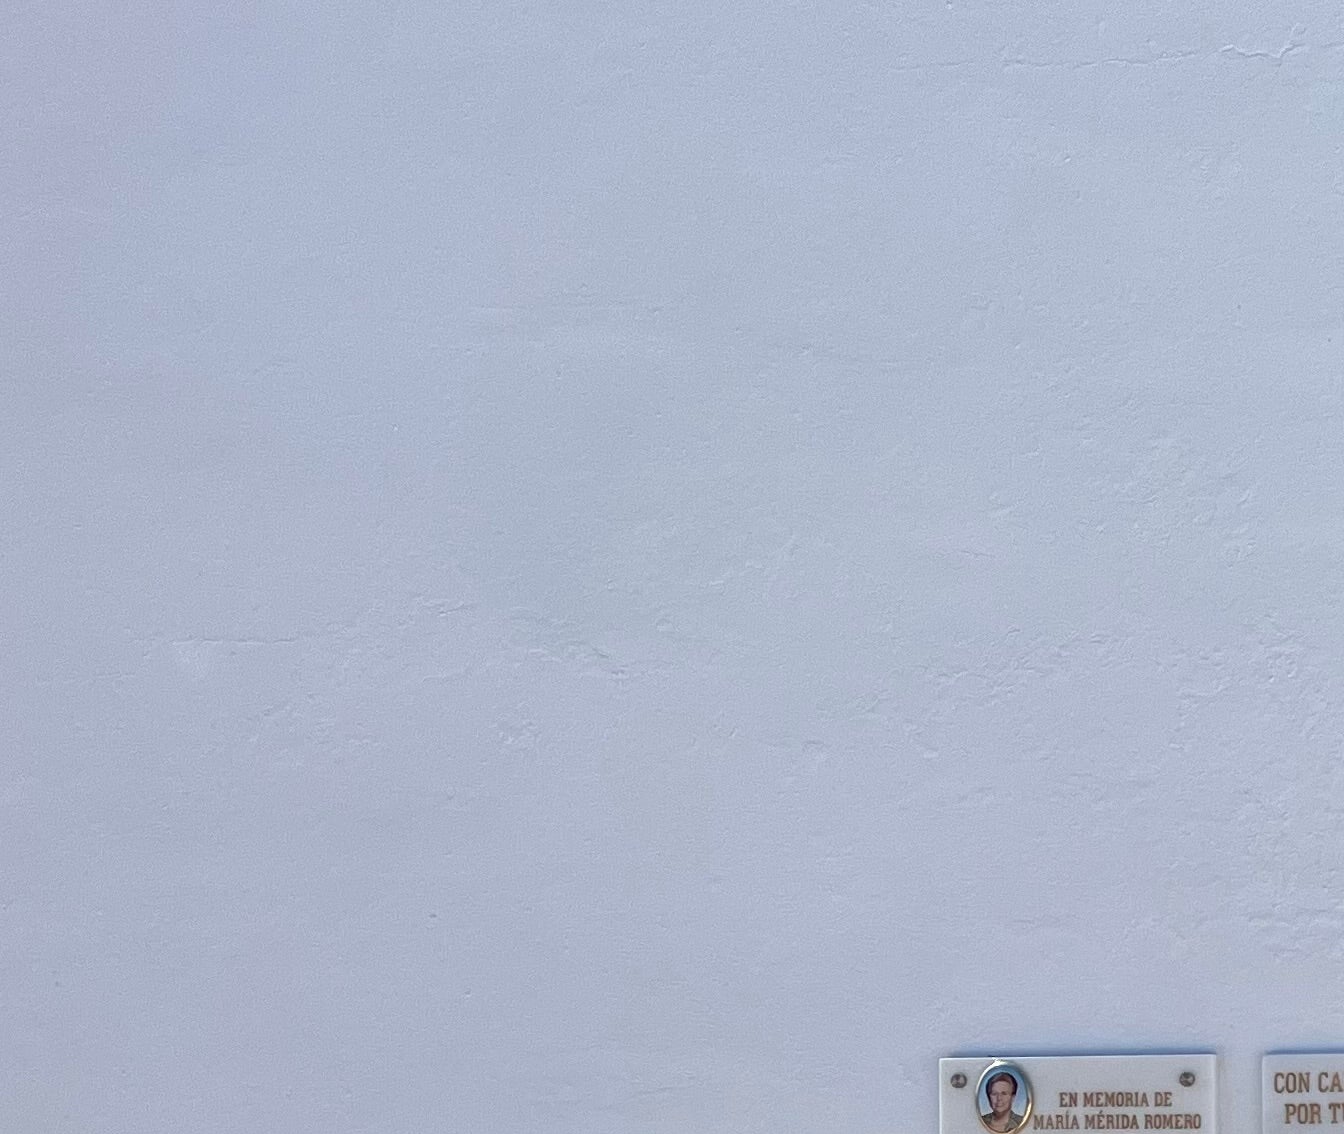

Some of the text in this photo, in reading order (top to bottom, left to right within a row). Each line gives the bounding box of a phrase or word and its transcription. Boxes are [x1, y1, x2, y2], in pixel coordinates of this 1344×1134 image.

[1274, 1072, 1310, 1094] CON
[1059, 1092, 1172, 1107] EN MEMORIA DE
[1033, 1110, 1201, 1130] MARÍA MÉRIDA ROMERO
[1284, 1103, 1322, 1124] POR
